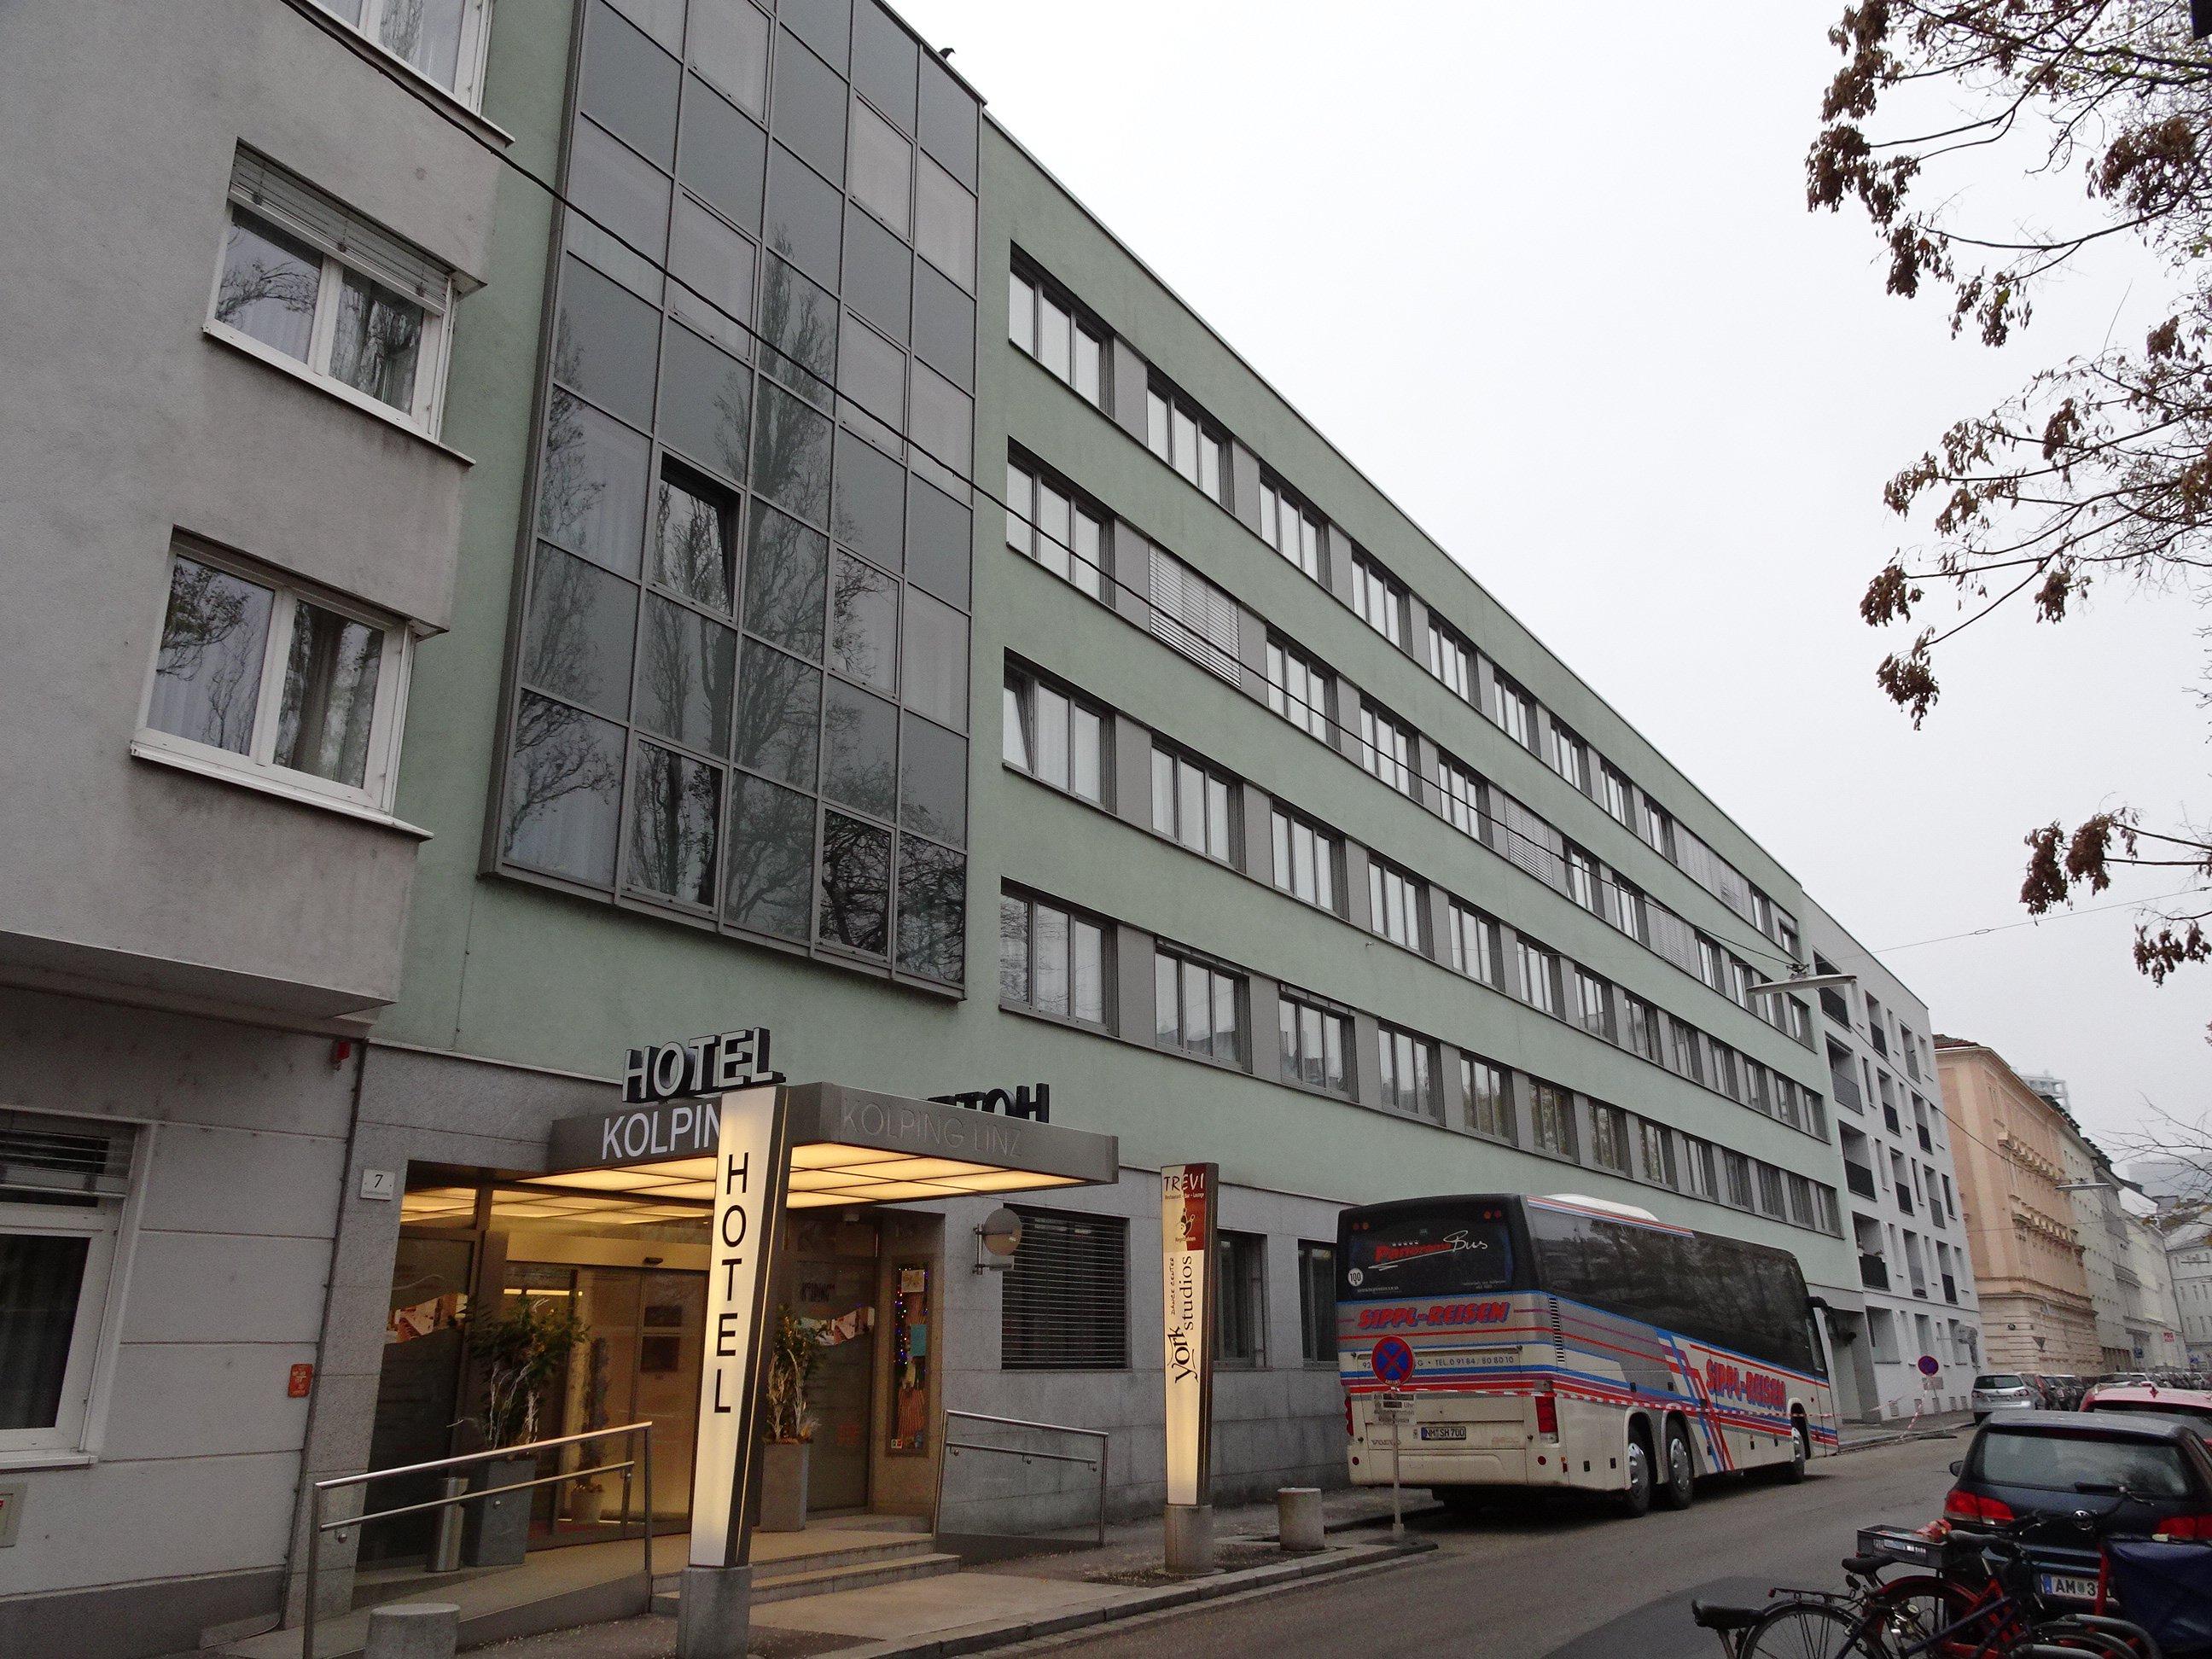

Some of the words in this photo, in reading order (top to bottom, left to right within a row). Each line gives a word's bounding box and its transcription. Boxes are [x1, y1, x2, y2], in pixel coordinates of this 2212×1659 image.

[621, 1027, 783, 1103] HOTEL
[602, 1103, 719, 1160] KOLPIN
[840, 1090, 964, 1149] KOLPING
[974, 1118, 1022, 1159] LINZ
[374, 1173, 384, 1188] 7
[1163, 1173, 1205, 1191] TREVI
[1443, 1230, 1488, 1253] Bus
[713, 1151, 749, 1414] HOTEL
[1349, 1272, 1362, 1282] 100
[1179, 1255, 1194, 1330] studios
[1357, 1301, 1511, 1329] SIPPL-REISEN
[2056, 1579, 2076, 1594] AM
